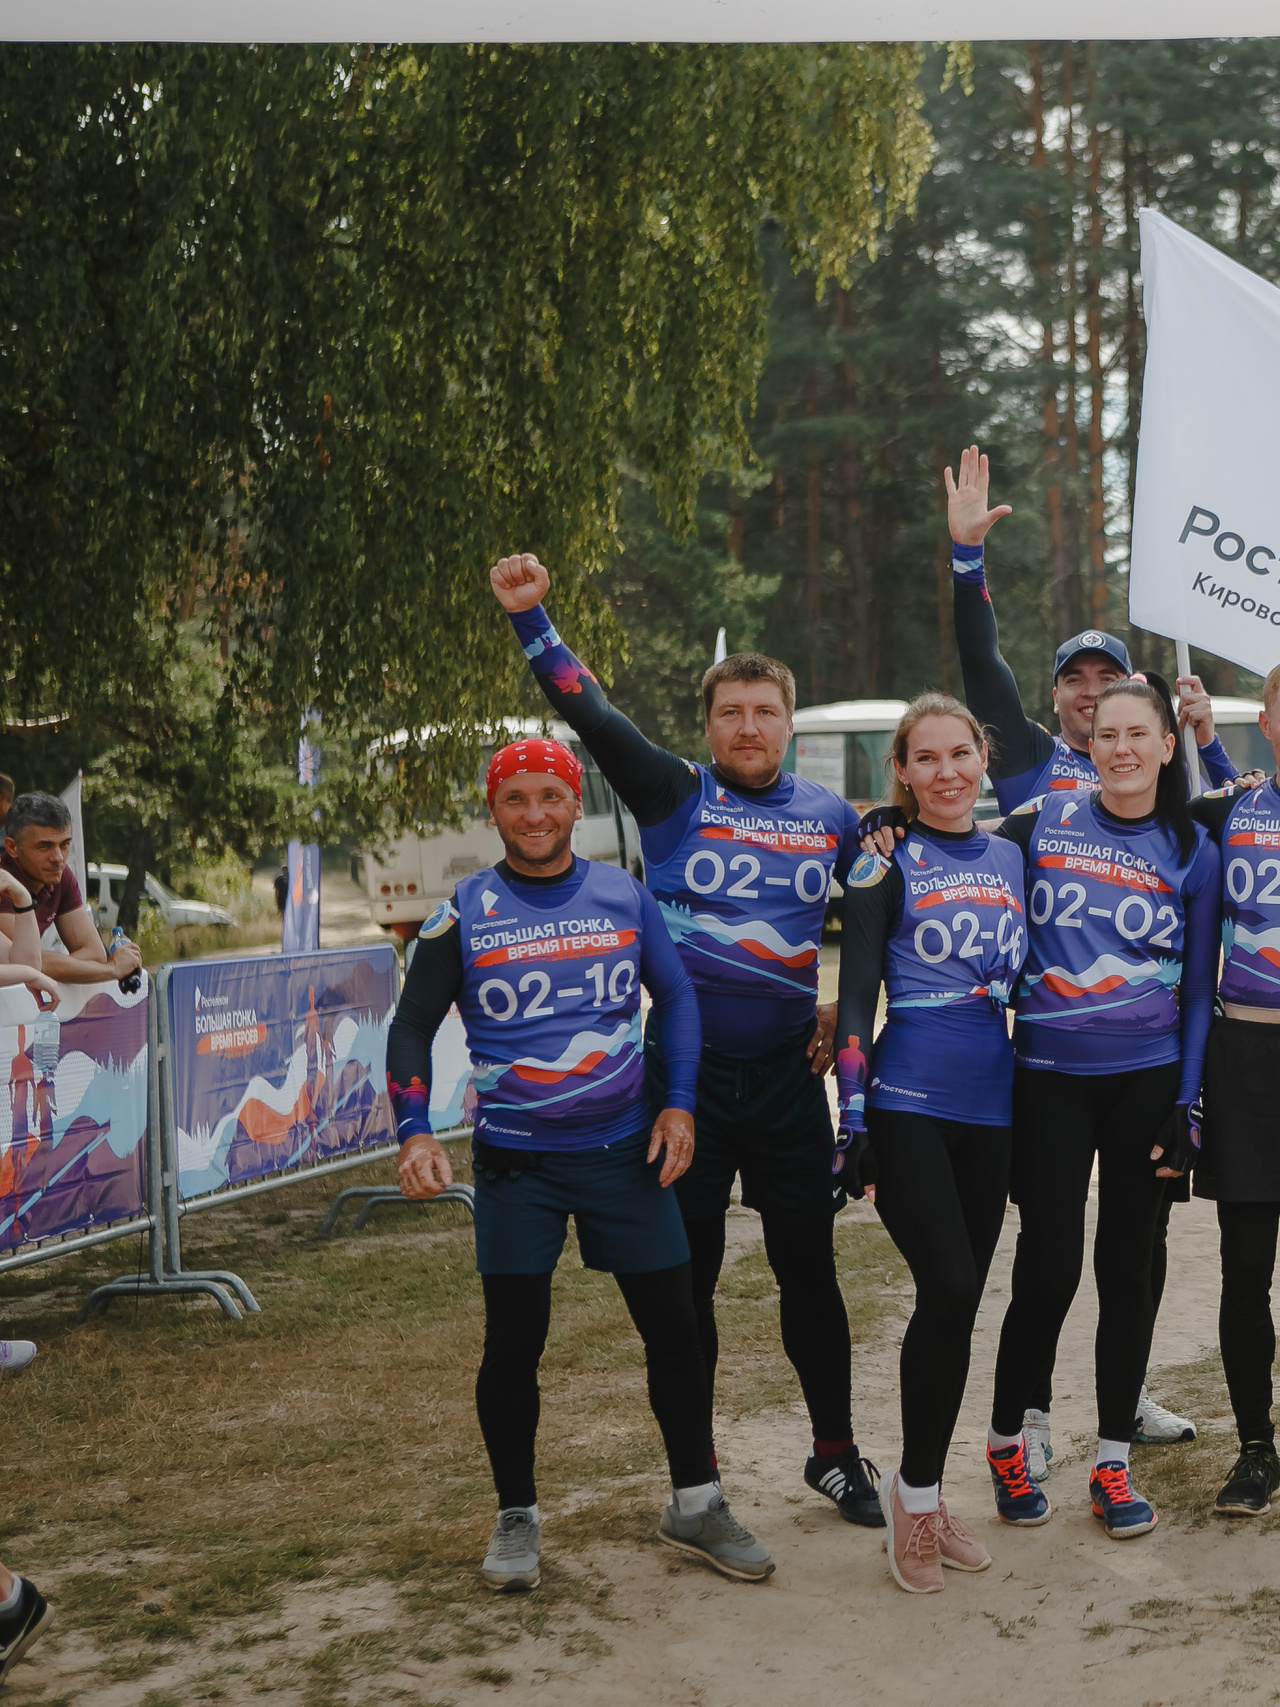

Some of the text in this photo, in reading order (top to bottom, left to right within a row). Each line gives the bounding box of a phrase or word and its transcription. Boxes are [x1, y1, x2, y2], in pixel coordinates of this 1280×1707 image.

[700, 810, 825, 834] БОЛЬШАЯ ГОНКА
[1044, 827, 1085, 837] Ростелеком
[733, 828, 827, 848] ВРЕМЯ ГЕРОЕВ
[1037, 838, 1157, 874] БОЛЬШАЯ ГОНКА
[910, 872, 1013, 895] БОЛЬШАЯ ГОНА
[1064, 857, 1160, 889] ВРЕМЯ ГЕРОЕВ
[471, 917, 518, 931] Ростелеком
[1030, 879, 1179, 948] 02-02
[469, 918, 616, 951] БОЛЬШАЯ ГОНКА
[507, 933, 620, 961] ВРЕМЯ ГЕРОЕВ
[478, 959, 636, 1022] 02-10
[195, 1008, 258, 1035] БОЛЬШАЯ ГОНКА
[211, 1028, 259, 1051] ВРЕМЯ ГЕРОЕВ
[880, 1083, 928, 1099] Ростелеком
[485, 1123, 532, 1137] Ростелеком
